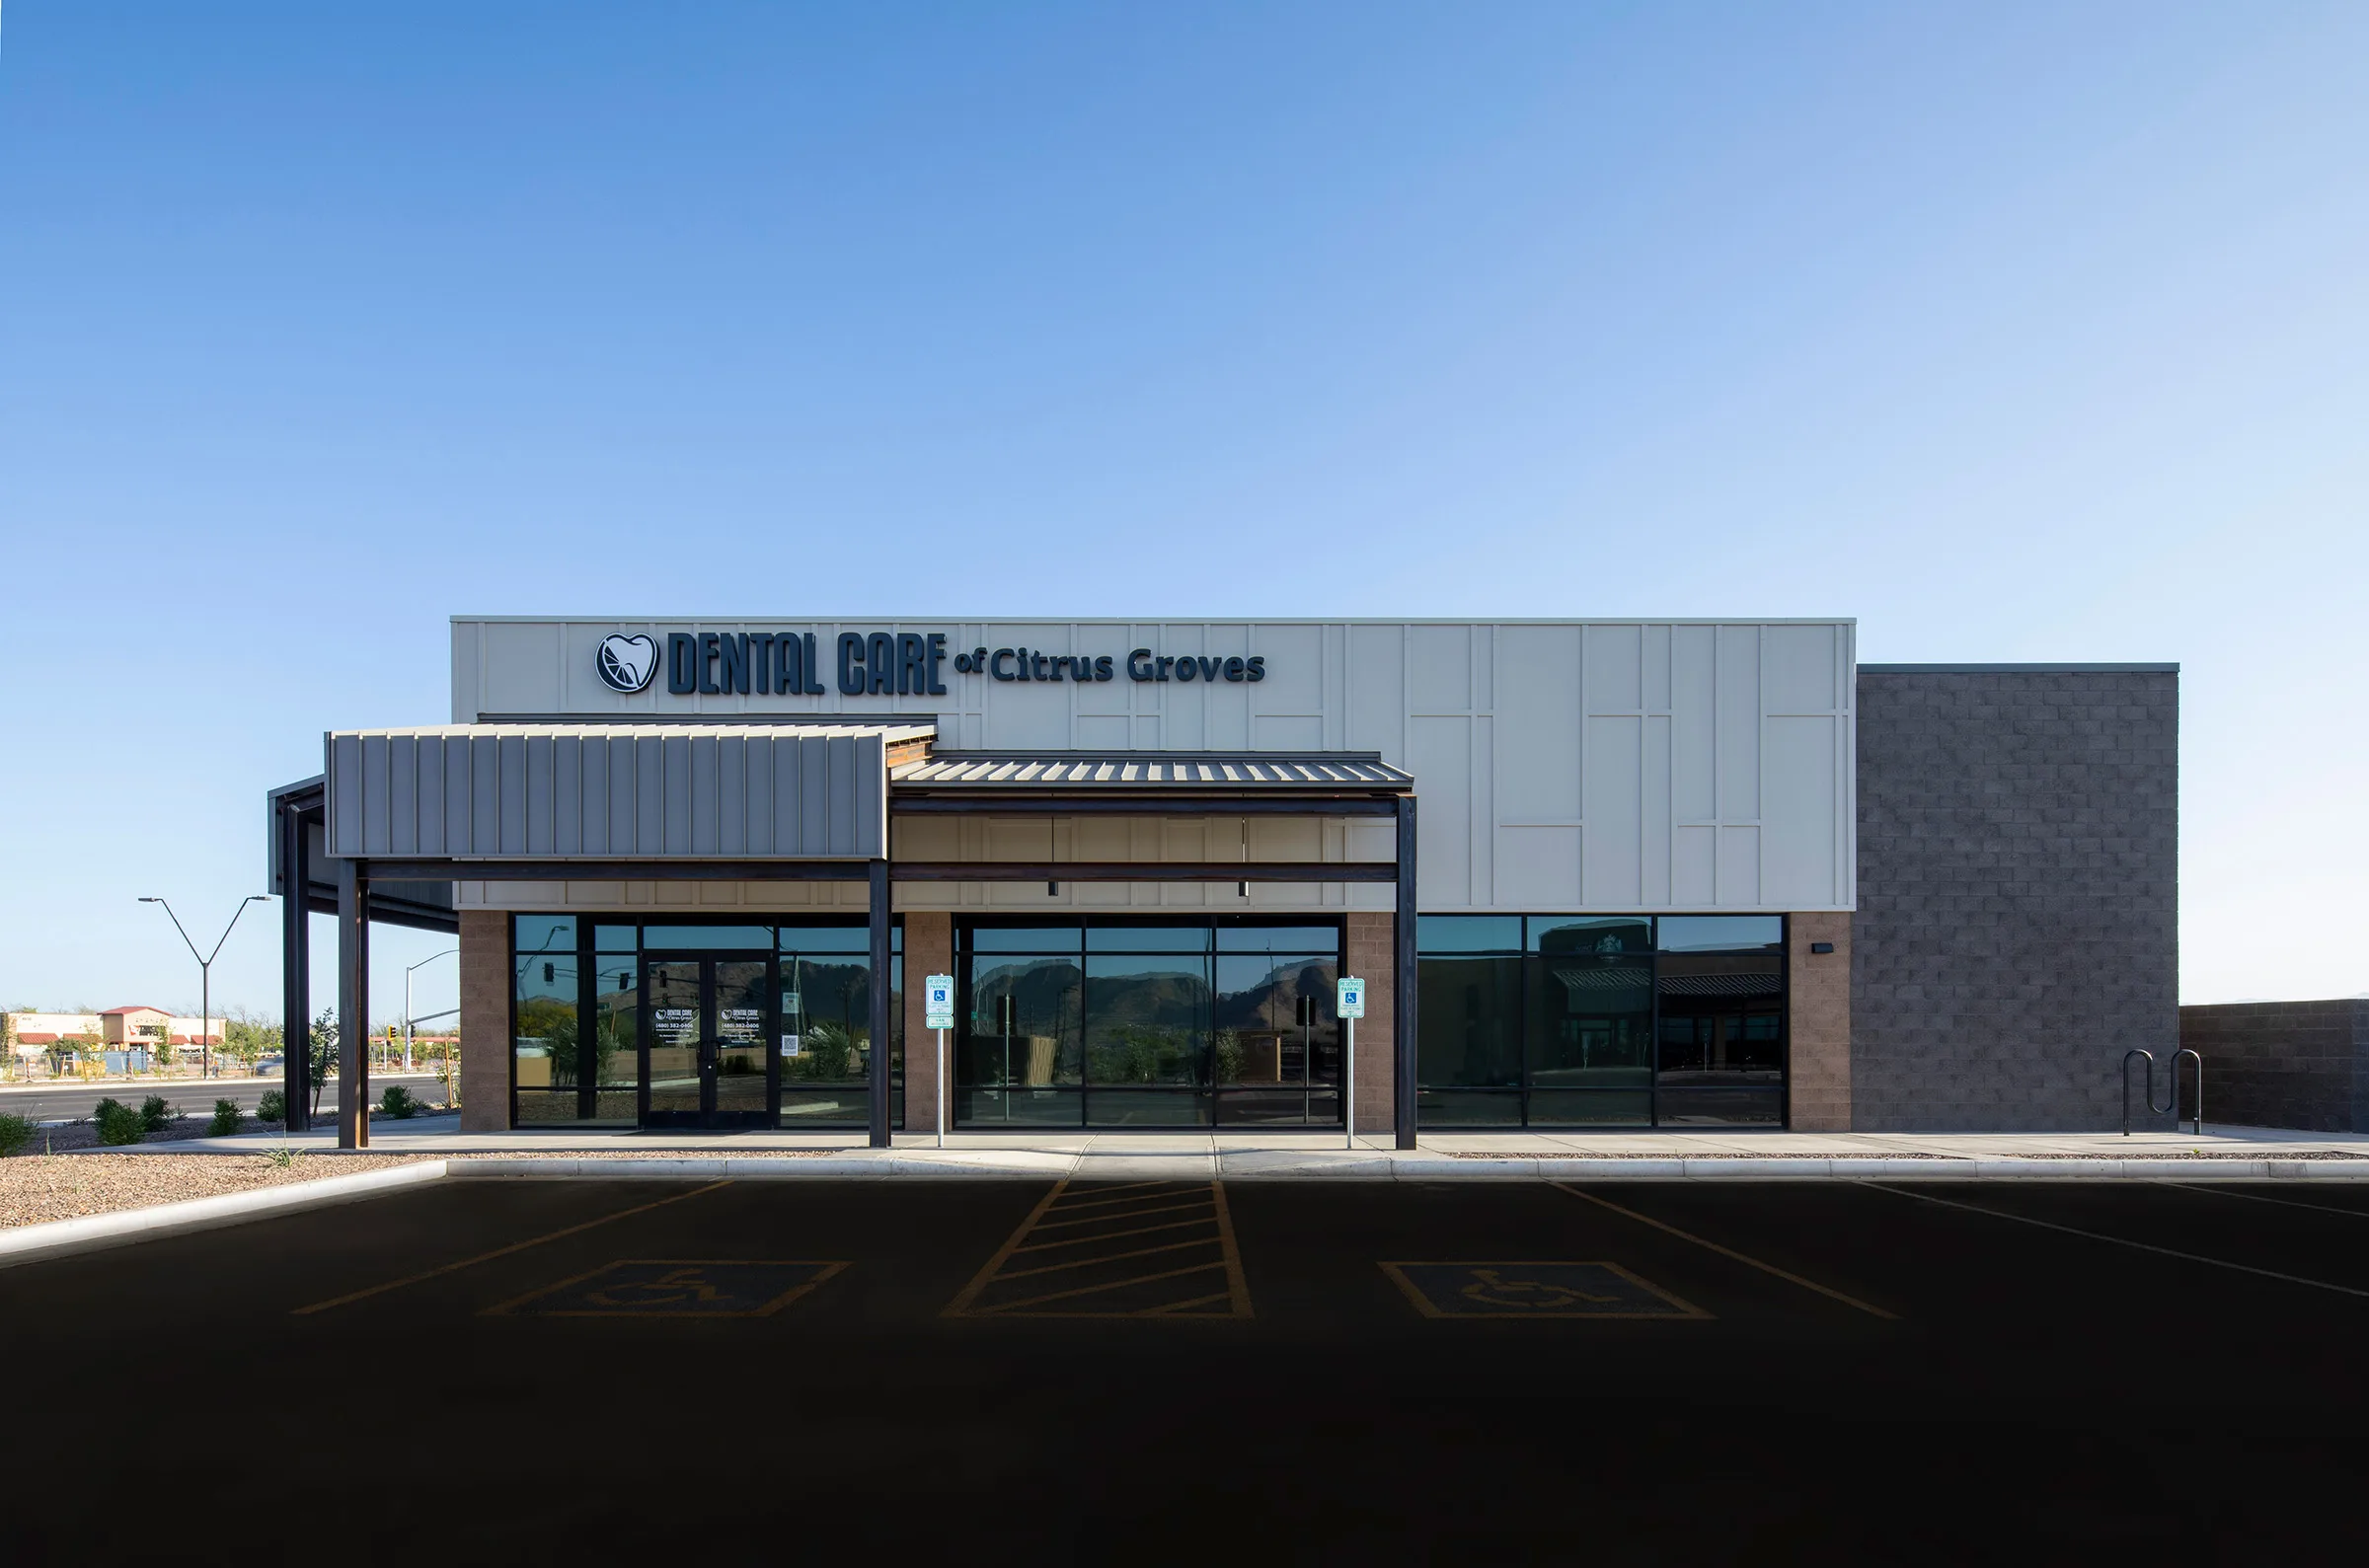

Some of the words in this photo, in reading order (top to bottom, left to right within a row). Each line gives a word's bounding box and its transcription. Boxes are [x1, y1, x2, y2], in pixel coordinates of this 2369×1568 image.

[667, 633, 825, 695] DENTAL
[837, 633, 948, 696] CARE
[955, 647, 987, 673] of
[991, 647, 1113, 681] Citrus
[1127, 648, 1265, 682] Groves
